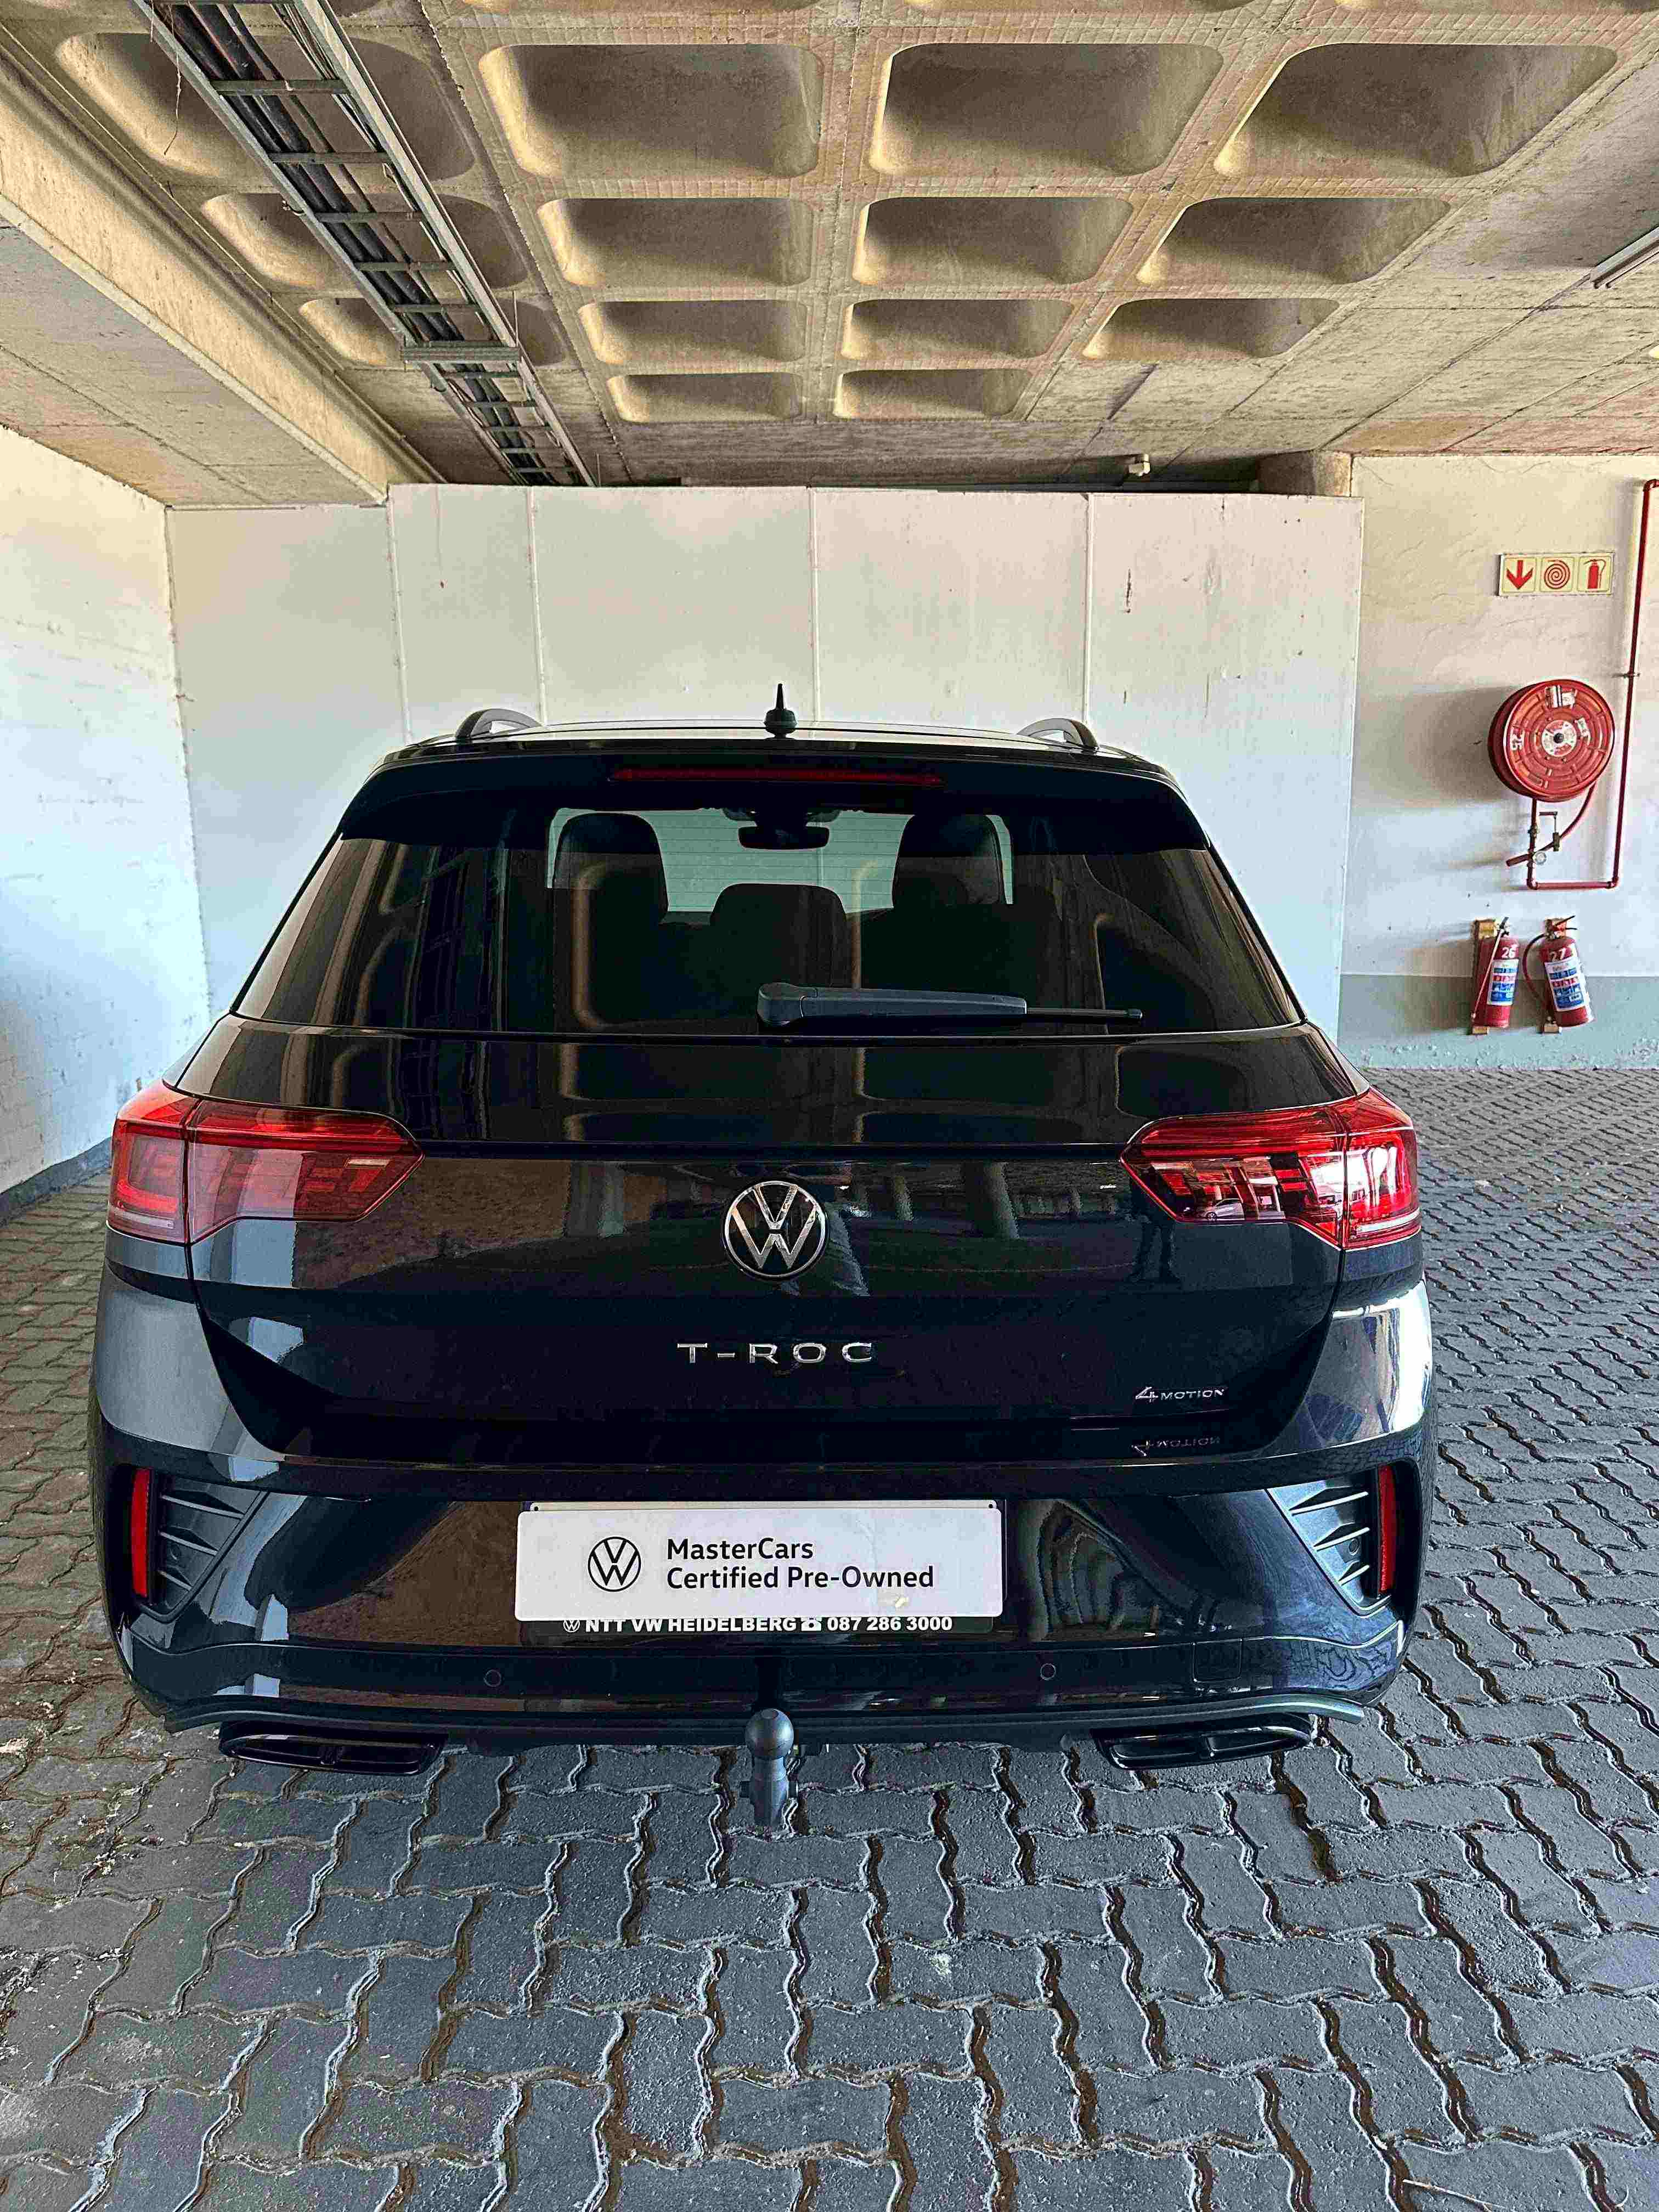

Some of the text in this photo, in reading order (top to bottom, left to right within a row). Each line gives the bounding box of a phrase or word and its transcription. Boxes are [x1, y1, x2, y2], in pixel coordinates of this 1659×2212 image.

[1502, 946, 1516, 958] 26
[725, 1182, 825, 1276] VW
[676, 1342, 872, 1364] T-ROC
[1135, 1386, 1225, 1403] 4MOTION
[667, 1537, 814, 1560] MasterCars
[588, 1536, 641, 1592] VW
[667, 1565, 934, 1589] Certified Pre-Owned
[585, 1618, 626, 1633] NTT
[630, 1617, 663, 1633] VW
[668, 1617, 797, 1632] HEIDELBERG
[826, 1617, 862, 1632] 087
[866, 1617, 902, 1632] 286
[906, 1616, 953, 1631] 3000
